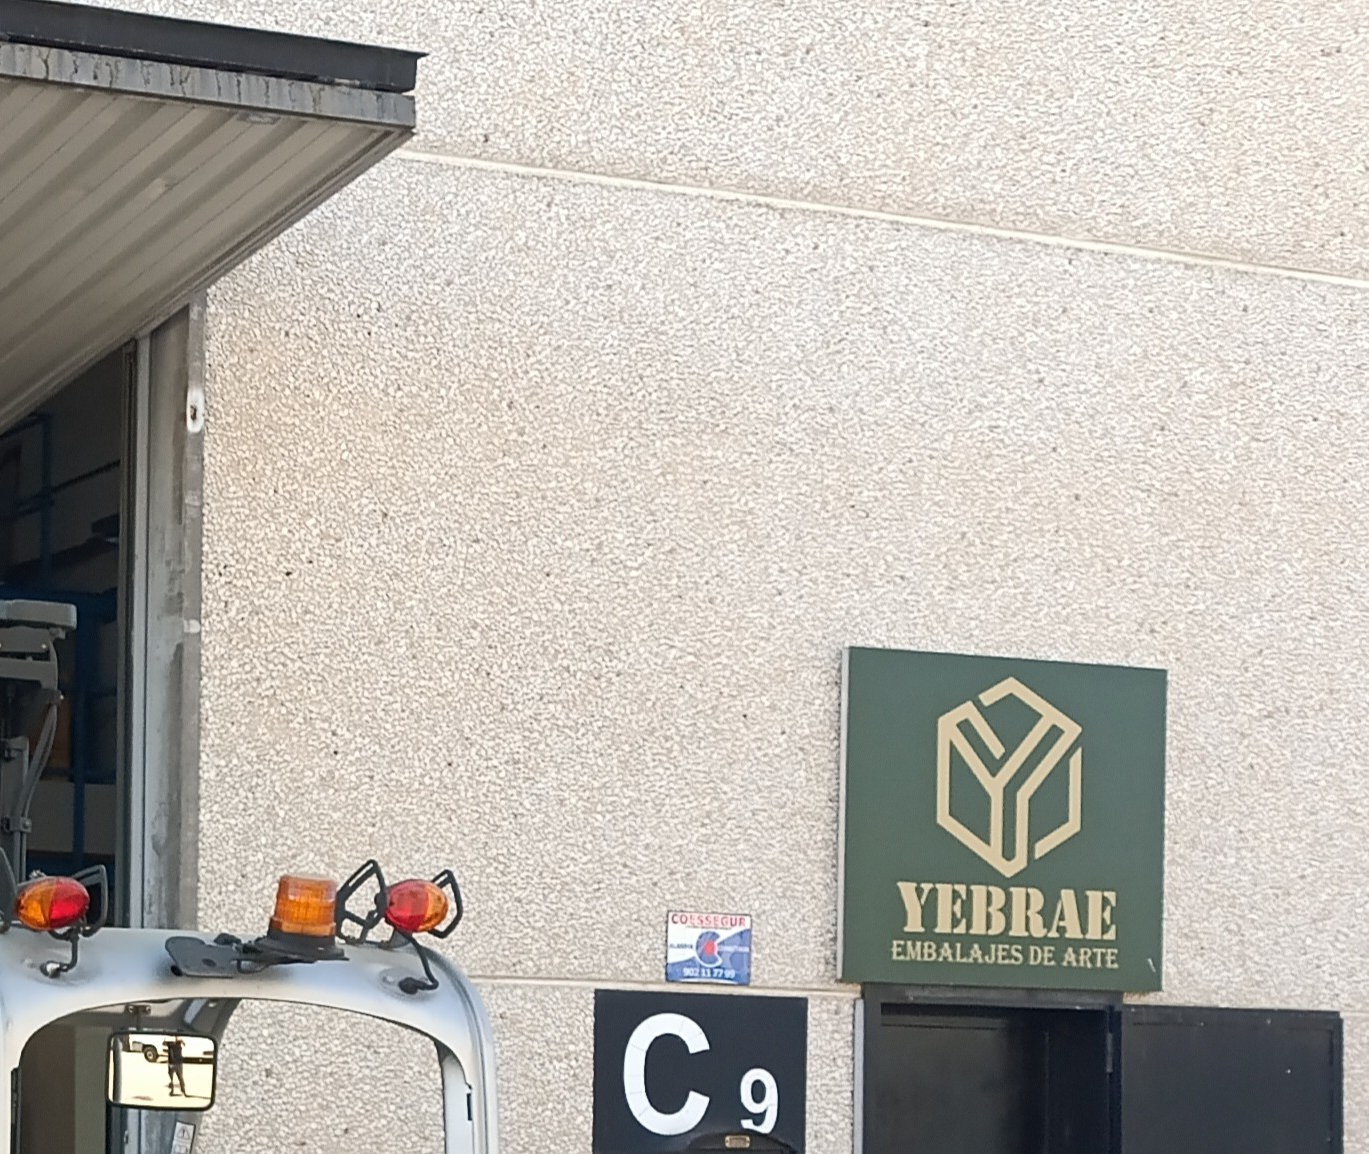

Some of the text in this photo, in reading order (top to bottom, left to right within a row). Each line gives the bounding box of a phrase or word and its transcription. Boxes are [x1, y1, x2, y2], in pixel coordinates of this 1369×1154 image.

[671, 913, 746, 927] COESSEGUR
[896, 881, 1117, 941] YEBRAE
[891, 940, 1119, 969] EMBALAJES DE ARTE
[623, 1012, 779, 1136] C 9
